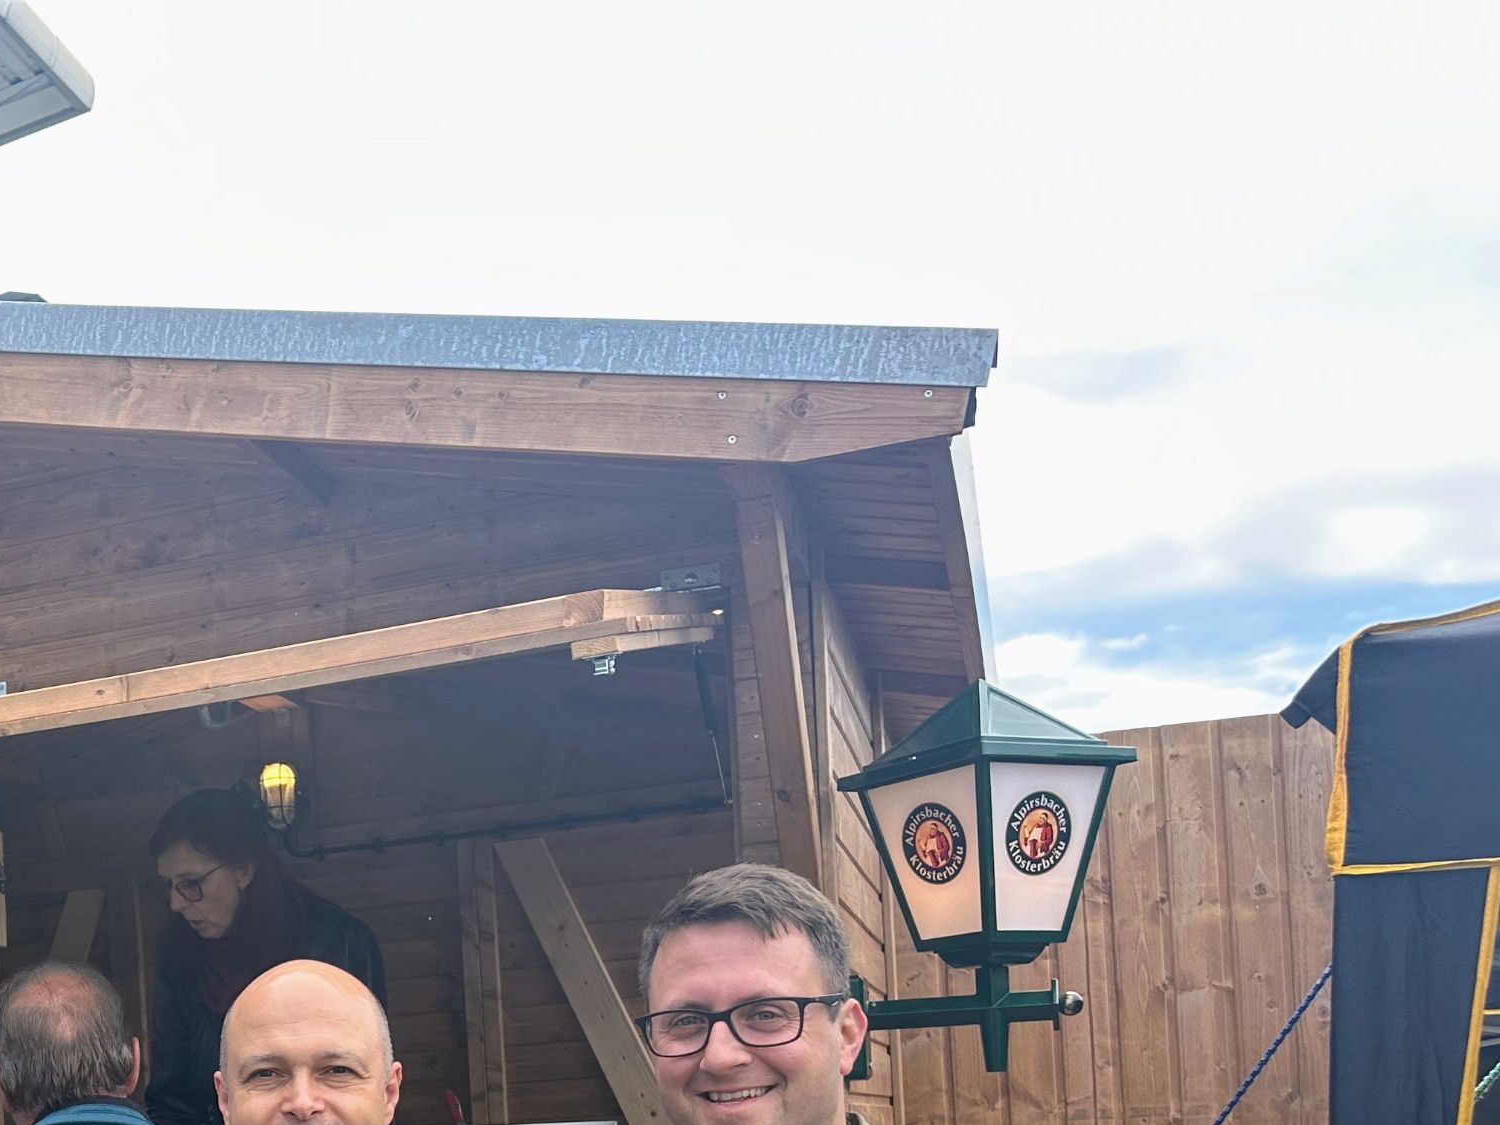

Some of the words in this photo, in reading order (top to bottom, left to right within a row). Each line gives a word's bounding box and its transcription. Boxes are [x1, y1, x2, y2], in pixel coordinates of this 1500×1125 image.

[905, 806, 959, 846] Alpirsbacher
[1010, 794, 1067, 832] Alpirsbacher
[910, 846, 964, 881] Klosterbräu
[1009, 840, 1067, 872] Klosterbräu
